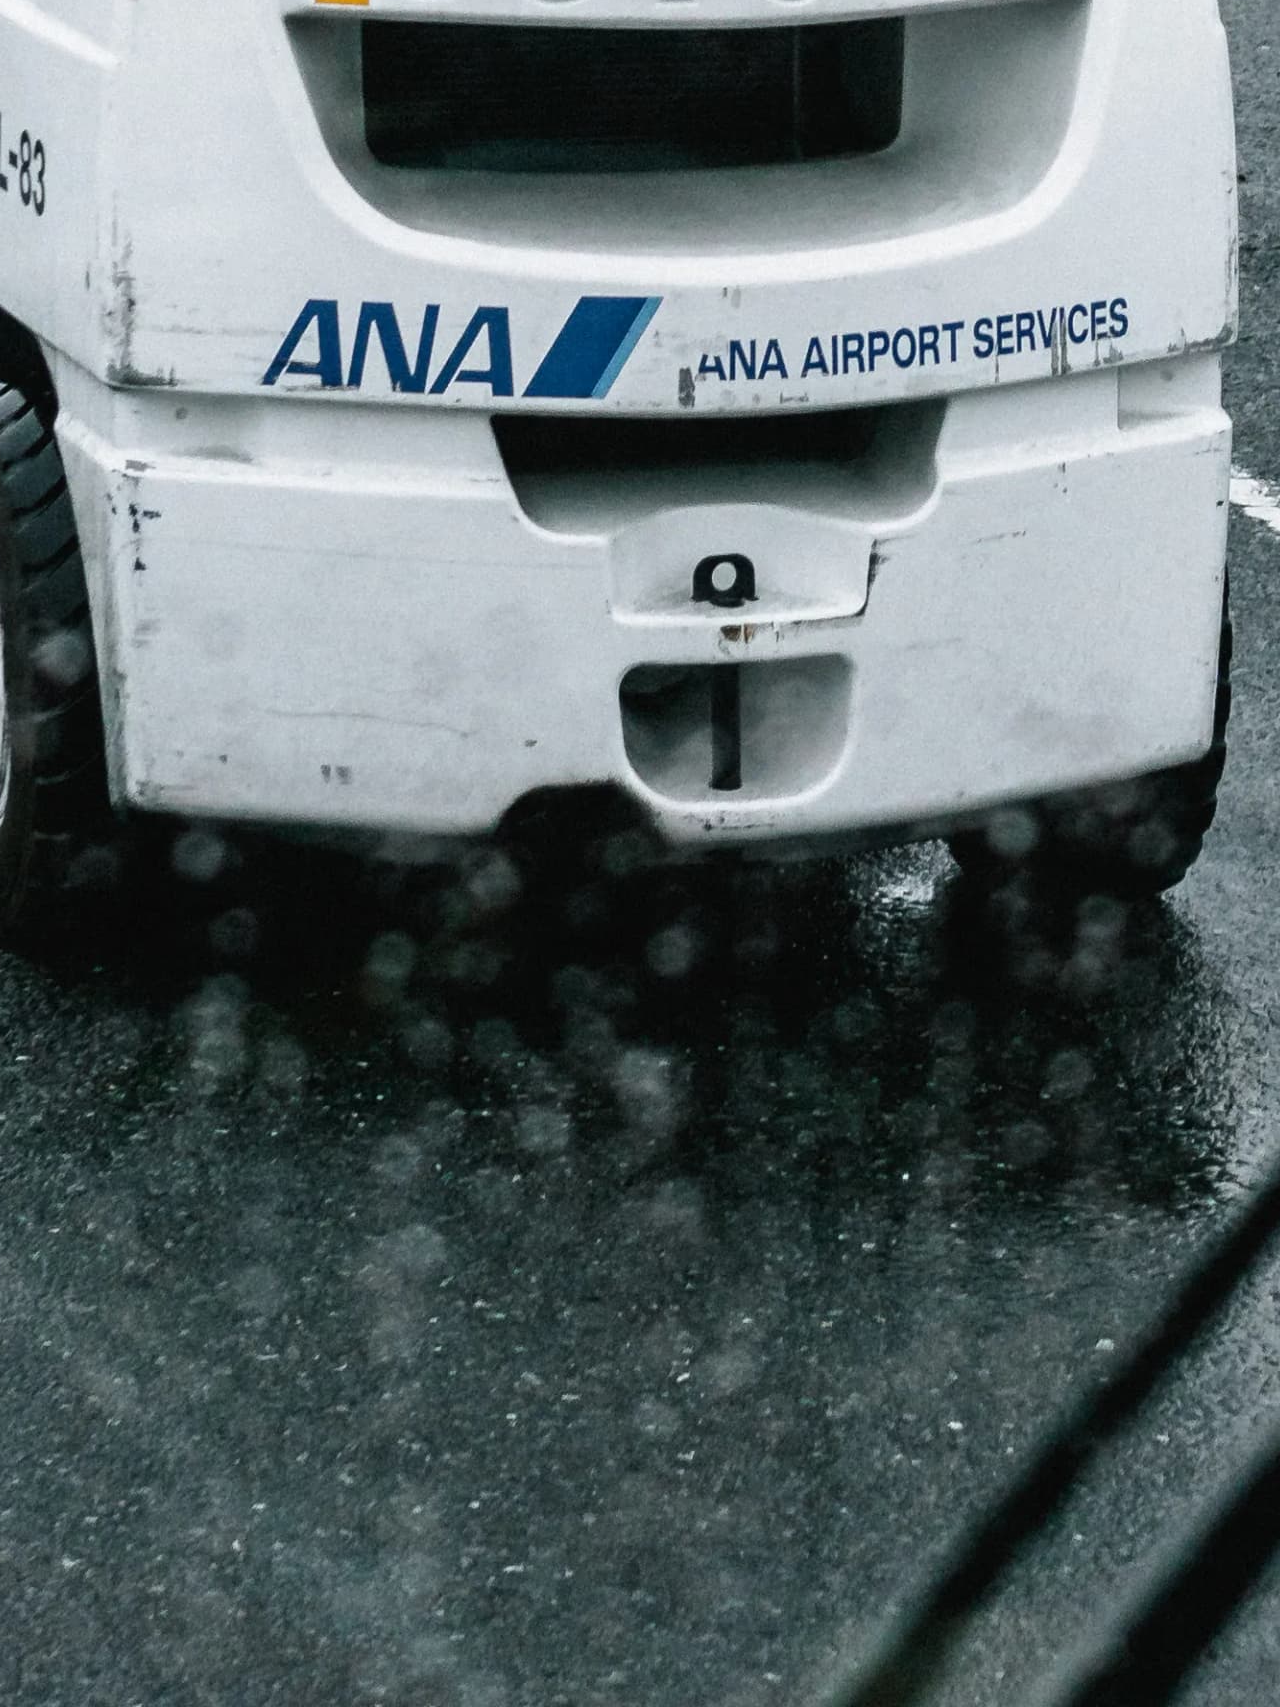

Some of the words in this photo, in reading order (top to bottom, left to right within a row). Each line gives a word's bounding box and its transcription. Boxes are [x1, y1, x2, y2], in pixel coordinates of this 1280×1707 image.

[261, 299, 515, 398] ANA
[698, 338, 789, 381] ANA
[800, 321, 965, 377] AIRPORT
[972, 297, 1129, 359] SERVICES
